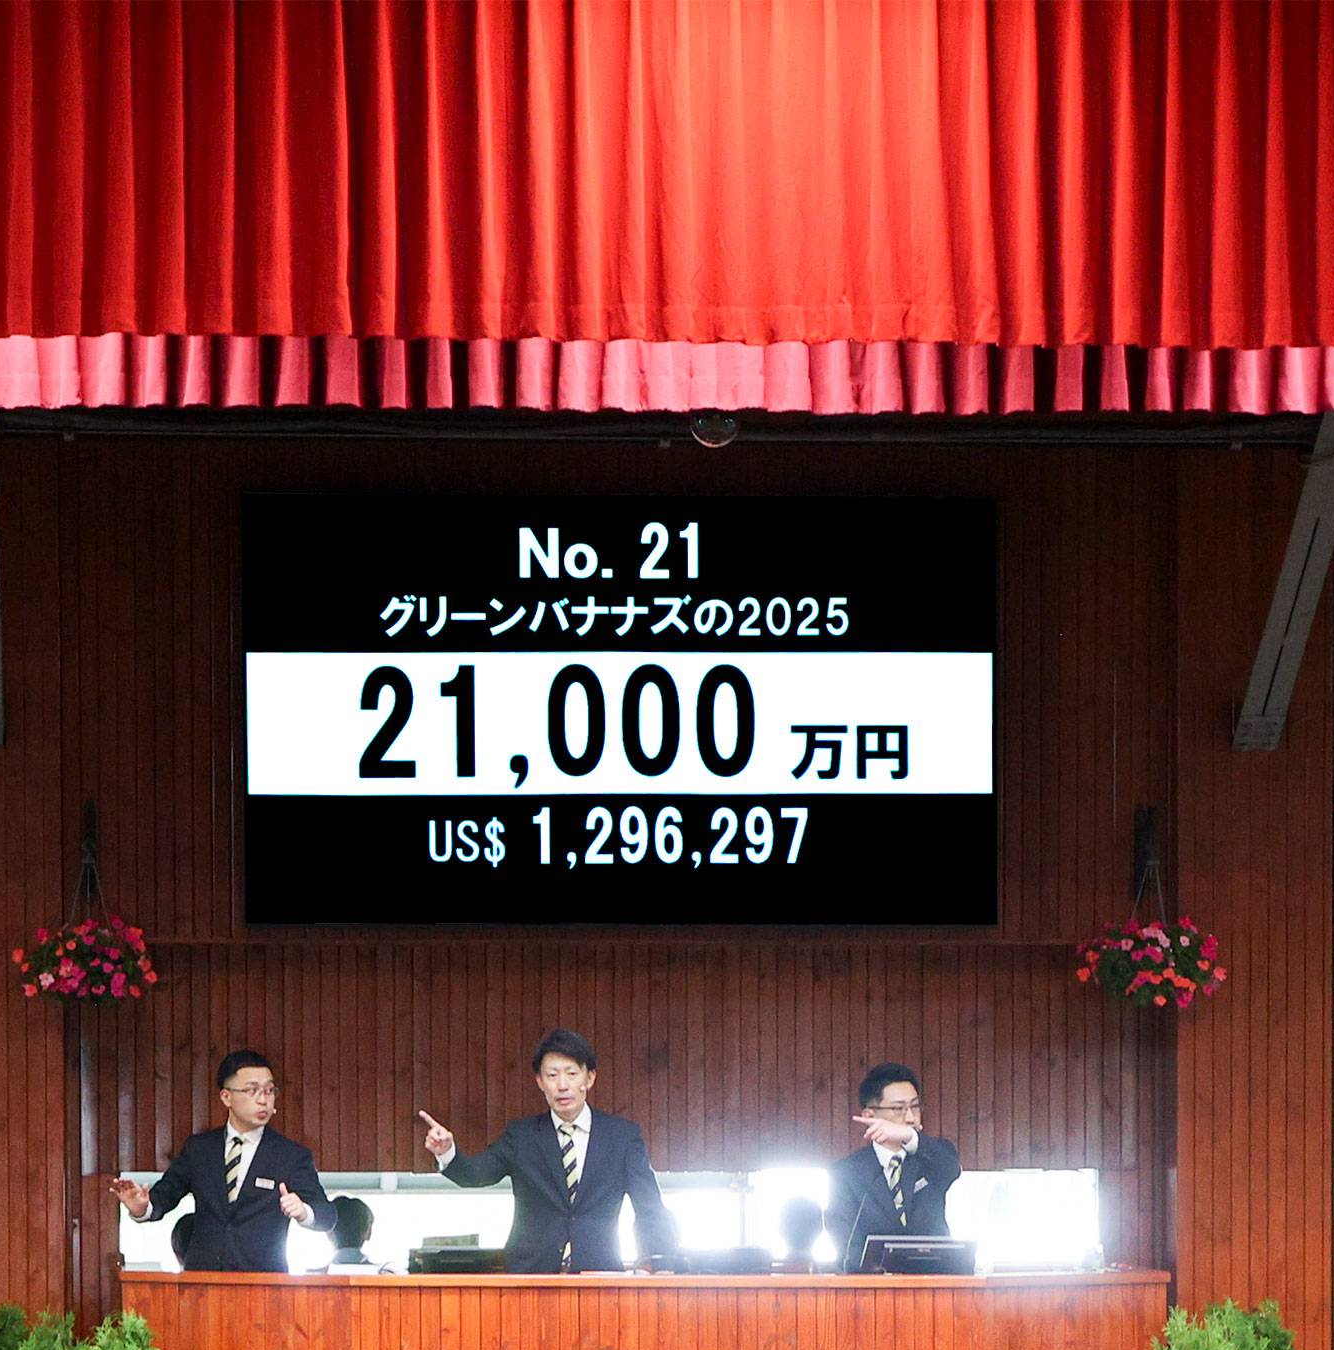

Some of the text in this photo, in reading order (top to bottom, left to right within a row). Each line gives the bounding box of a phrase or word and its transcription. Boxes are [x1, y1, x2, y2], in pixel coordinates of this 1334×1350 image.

[519, 521, 699, 579] No. 21
[380, 594, 850, 637] グリーンバナナズの2025
[359, 663, 909, 788] 21,000 万円
[429, 806, 808, 869] US$ 1,296,297
